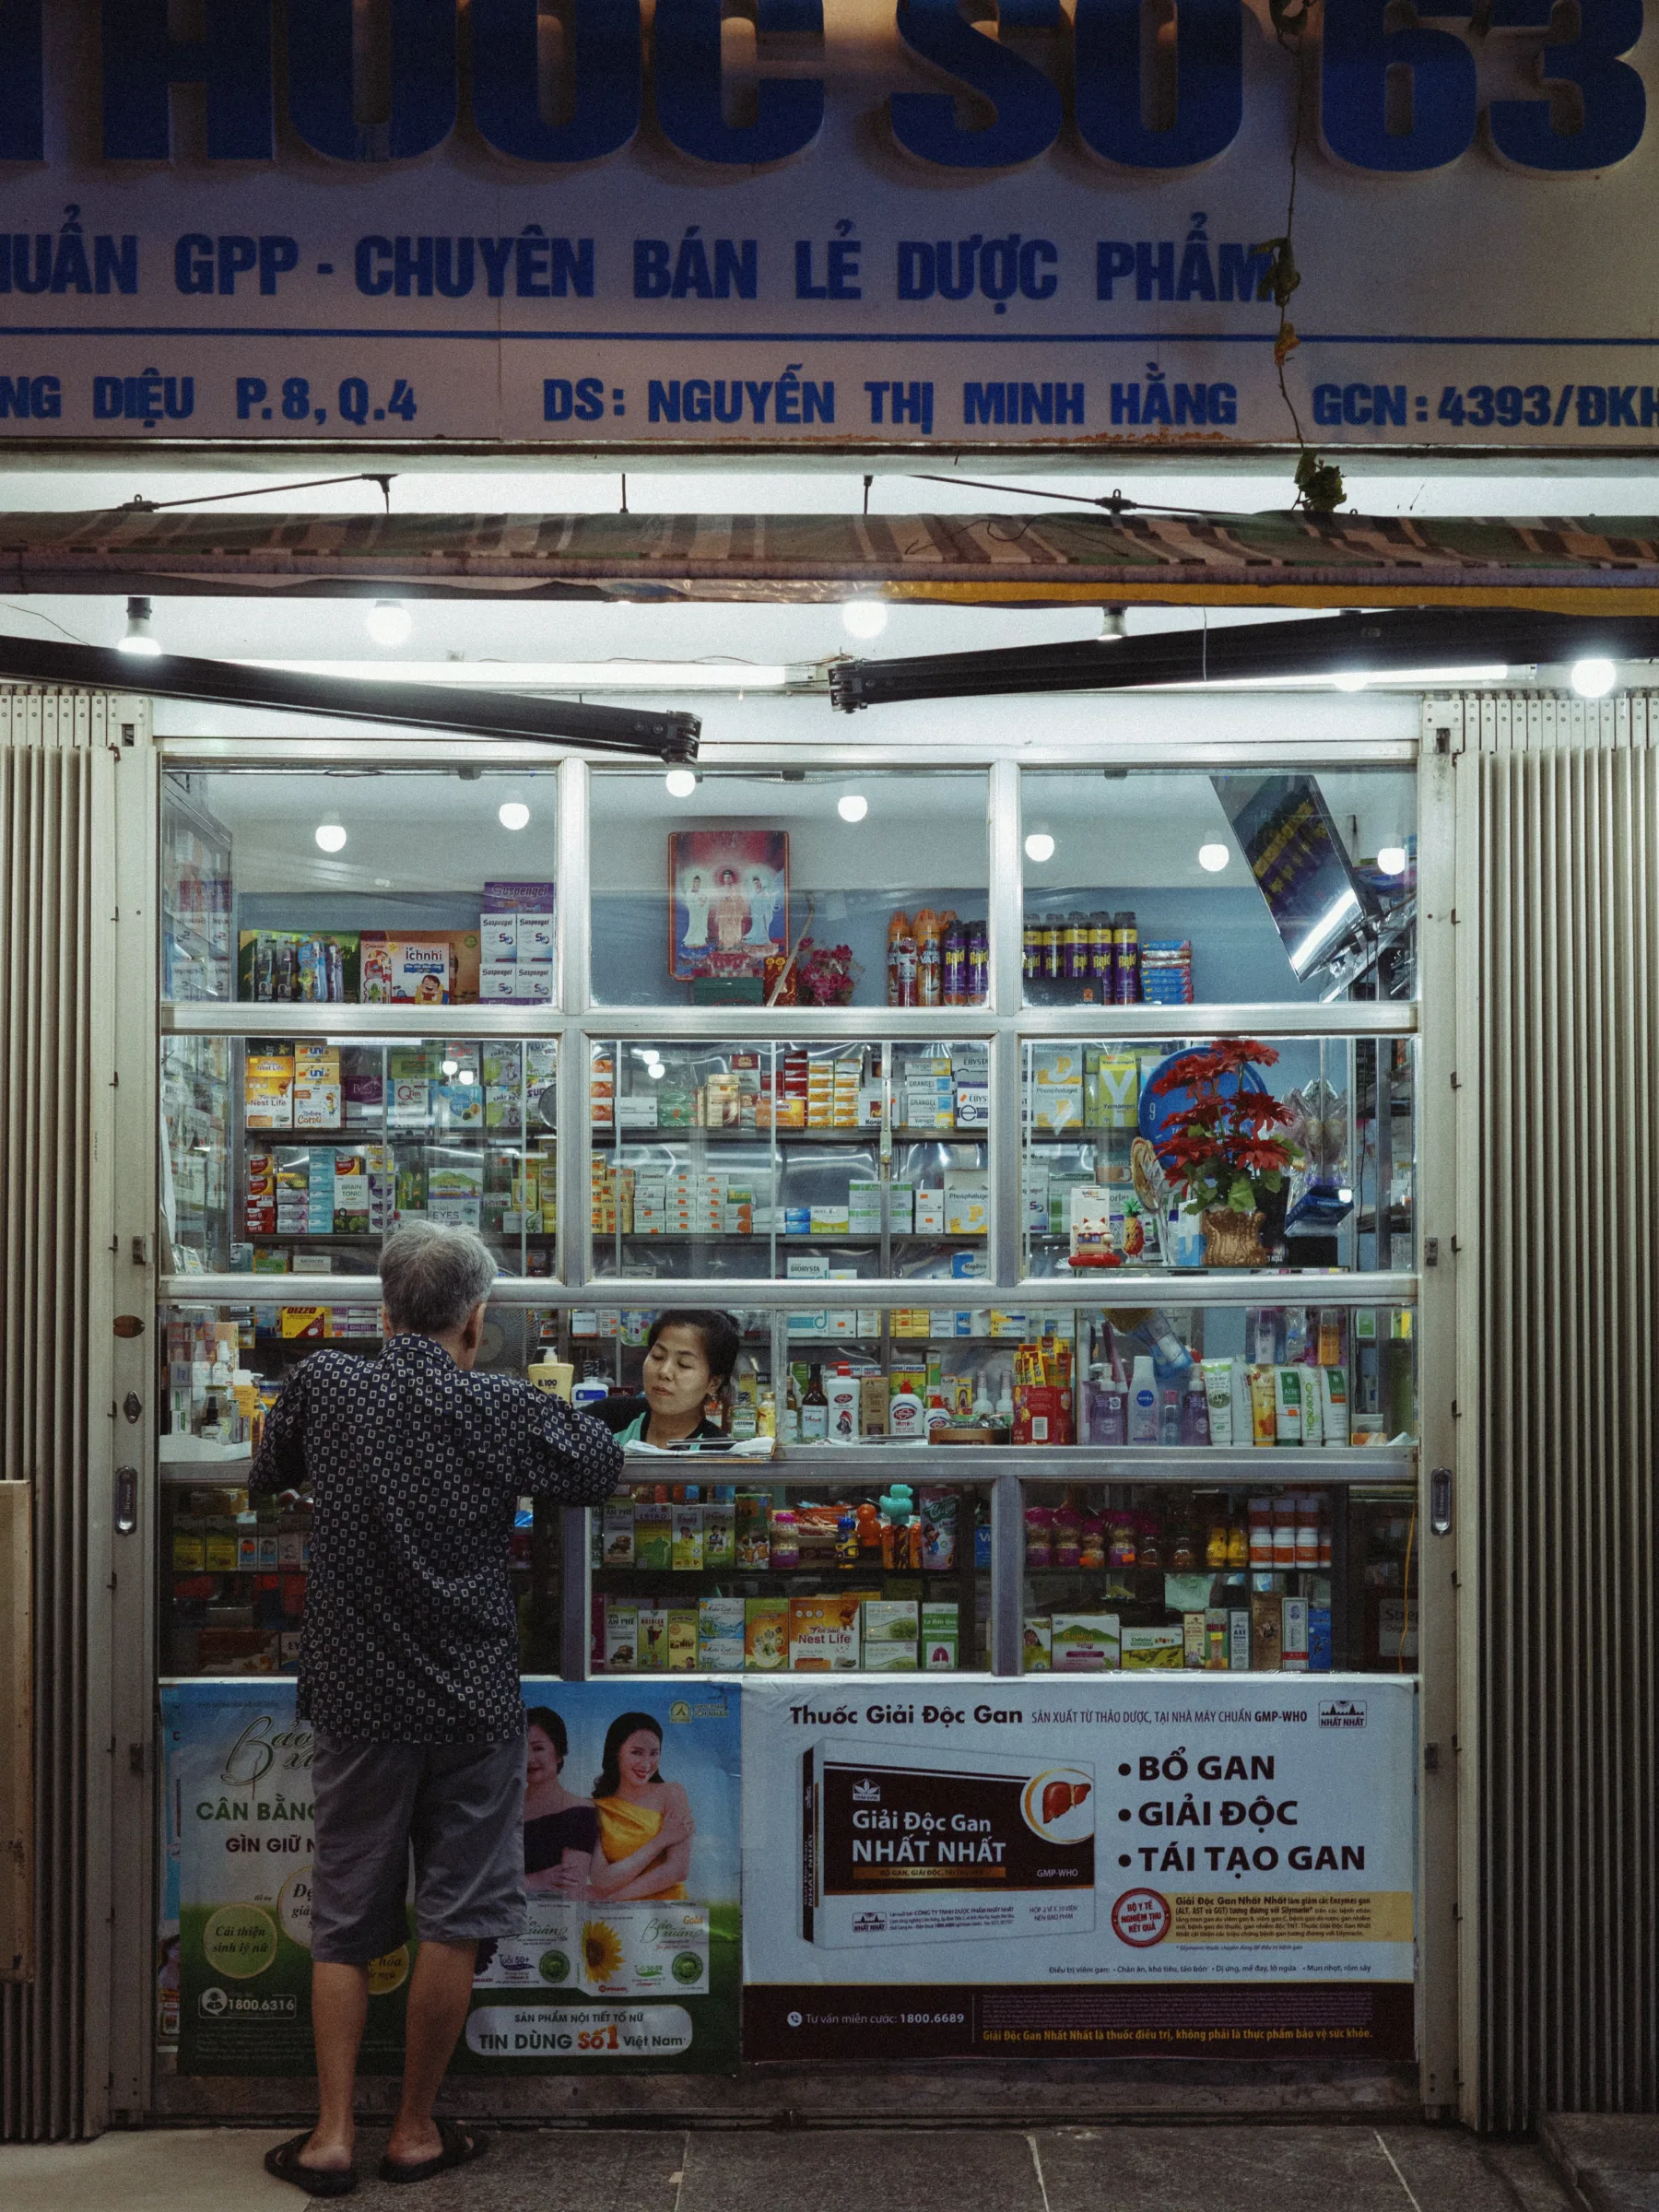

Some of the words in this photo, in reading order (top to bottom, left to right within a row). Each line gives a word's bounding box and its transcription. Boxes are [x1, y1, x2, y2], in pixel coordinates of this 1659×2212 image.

[1320, 0, 1647, 172] 63
[175, 231, 300, 296] GPP
[354, 224, 596, 300] CHUYÊN
[632, 226, 759, 300] BÁN
[794, 219, 862, 301] LẺ
[897, 234, 1059, 315] DƯỢC
[1096, 211, 1277, 302] PHẨM
[93, 368, 195, 429] DIỆU
[543, 378, 627, 424] DS:
[647, 363, 835, 427] NGUYỄN
[864, 380, 935, 436] THỊ
[963, 380, 1086, 427] MINH
[1110, 362, 1238, 427] HẰNG
[945, 949, 965, 967] Raid
[1118, 953, 1137, 972] Raid
[1036, 1087, 1078, 1095] Phosphalugel
[250, 1099, 269, 1107] Nest
[270, 1098, 287, 1107] Life
[1148, 1102, 1157, 1121] 9
[432, 1210, 460, 1220] EYES
[798, 1633, 827, 1644] Nest
[829, 1633, 851, 1644] Life
[1233, 1629, 1247, 1637] AXE
[789, 1704, 858, 1724] Thuốc
[865, 1704, 914, 1724] Giải
[922, 1705, 965, 1728] Độc
[973, 1704, 1023, 1724] Gan
[1031, 1710, 1051, 1724] SẢN
[1053, 1709, 1079, 1724] XUẤT
[1079, 1709, 1094, 1724] TỪ
[1095, 1709, 1122, 1724] THẢO
[1154, 1711, 1171, 1725] TẠI
[1171, 1710, 1193, 1724] NHÀ
[1194, 1710, 1217, 1724] MÁY
[1218, 1708, 1253, 1723] CHUẨN
[1253, 1711, 1308, 1723] GMP-WHO
[1138, 1746, 1189, 1781] BỔ
[1197, 1755, 1275, 1781] GAN
[196, 1796, 249, 1821] CÂN
[1138, 1793, 1211, 1827] GIẢI
[1219, 1794, 1299, 1833] ĐỘC
[853, 1808, 898, 1830] Giải
[903, 1812, 946, 1836] Độc
[951, 1814, 992, 1832] Gan
[226, 1833, 260, 1853] GÌN
[265, 1833, 301, 1853] GIỮ
[852, 1833, 930, 1863] NHẤT
[938, 1835, 1006, 1863] NHẤT
[1137, 1841, 1195, 1872] TÁI
[1204, 1846, 1280, 1879] TẠO
[1288, 1845, 1366, 1871] GAN
[1036, 1867, 1078, 1879] GMP-WHO
[1218, 1897, 1237, 1905] Gan
[215, 1924, 235, 1937] Cải
[237, 1924, 265, 1939] thiện
[213, 1942, 237, 1953] sinh
[227, 1998, 296, 2013] 1800.6316
[514, 2011, 535, 2023] SẢN
[537, 2010, 568, 2023] PHẨM
[570, 2012, 590, 2026] NỘI
[592, 2011, 611, 2023] TIẾT
[629, 2010, 645, 2022] NỮ
[805, 2013, 818, 2024] Tư
[818, 2011, 837, 2024] vấn
[841, 2011, 868, 2024] miễn
[869, 2011, 898, 2024] cước:
[900, 2012, 965, 2024] 1800.6689
[478, 2033, 508, 2050] TIN
[514, 2030, 573, 2051] DÙNG
[623, 2034, 648, 2051] Việt
[982, 2029, 1002, 2041] Giải
[1003, 2030, 1022, 2043] Độc
[1022, 2030, 1042, 2041] Gan
[1043, 2029, 1068, 2041] Nhất
[1069, 2029, 1093, 2041] Nhất
[1106, 2029, 1135, 2041] thuốc
[1175, 2029, 1207, 2042] không
[1295, 2028, 1315, 2040] bảo
